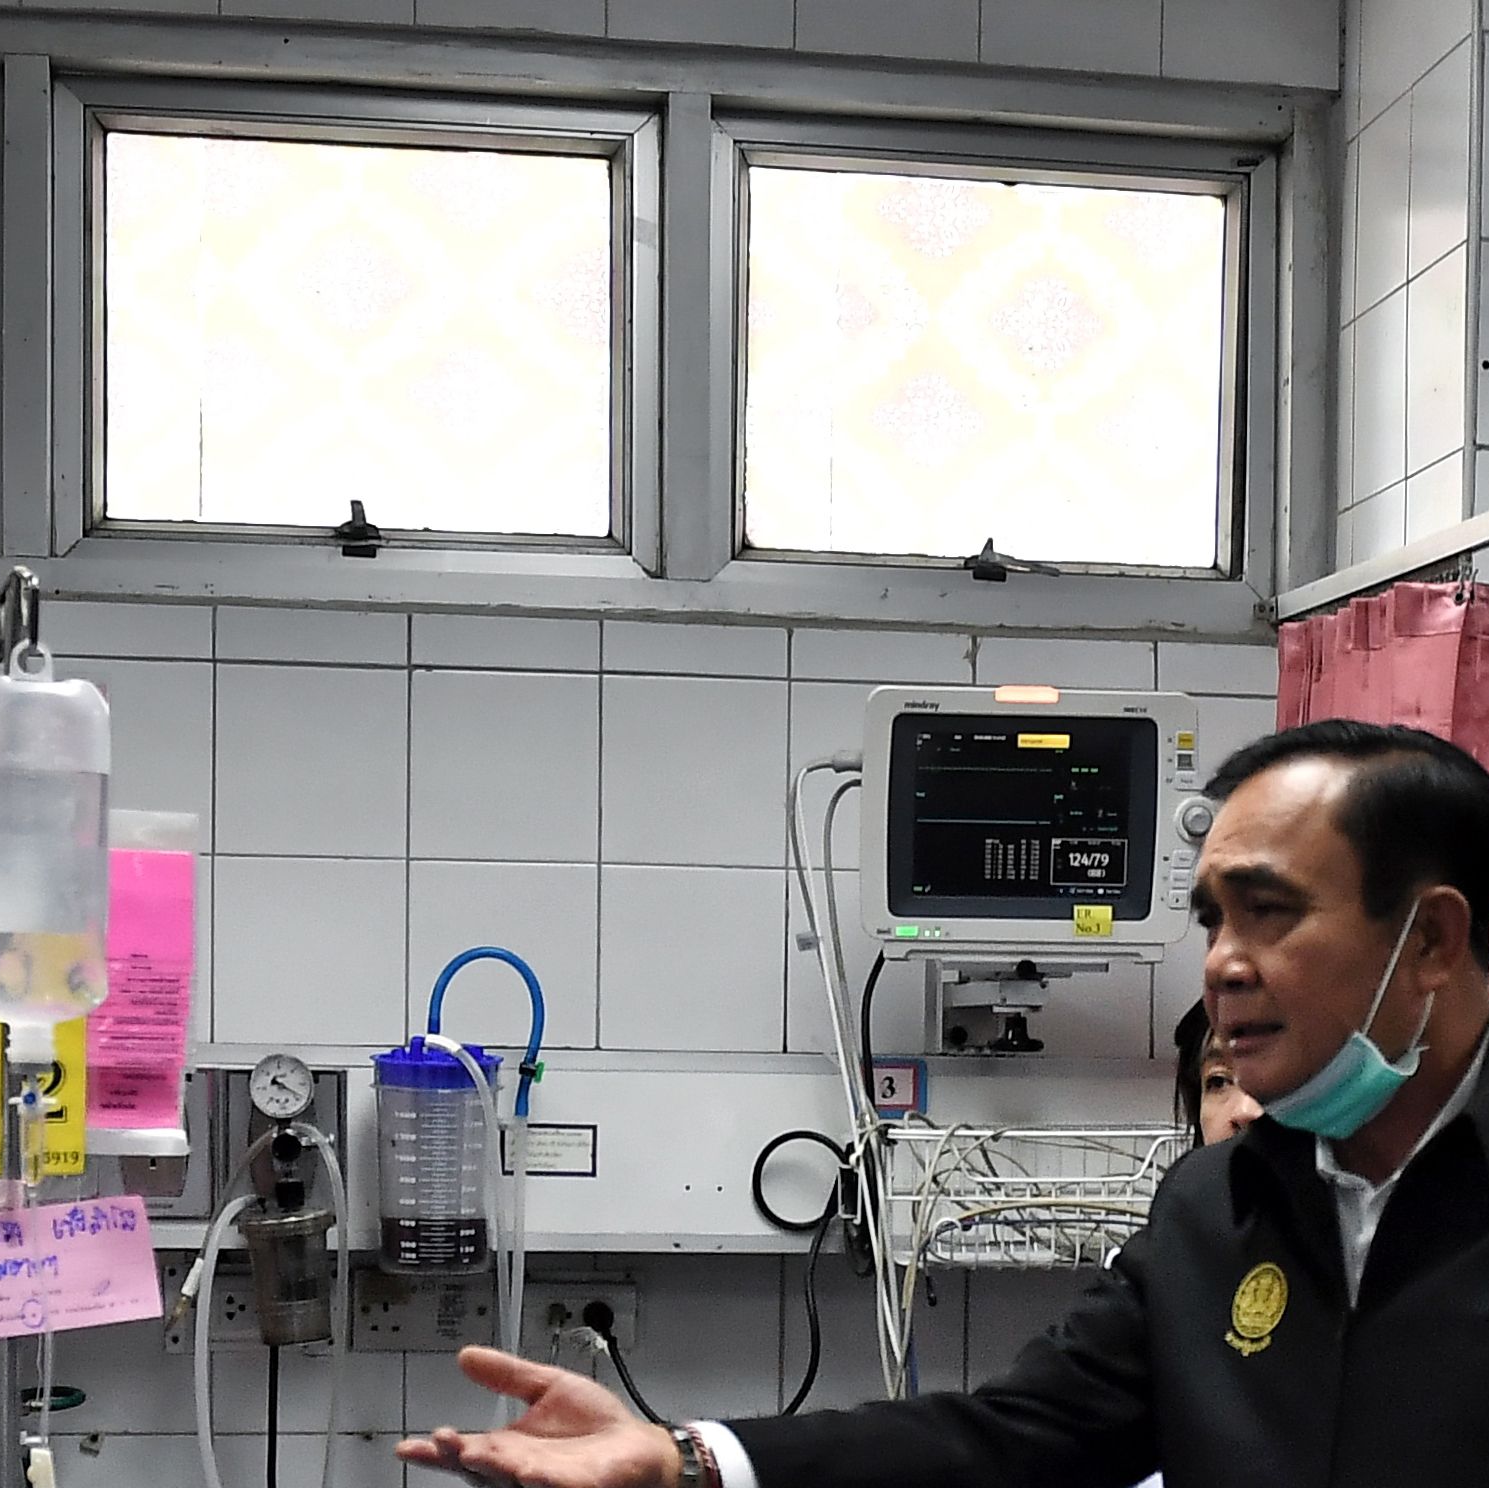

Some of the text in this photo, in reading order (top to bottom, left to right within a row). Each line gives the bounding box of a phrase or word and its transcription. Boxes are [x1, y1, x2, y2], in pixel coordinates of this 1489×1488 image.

[903, 699, 941, 712] mindray
[1068, 852, 1110, 868] 124/79
[881, 1076, 896, 1099] 3
